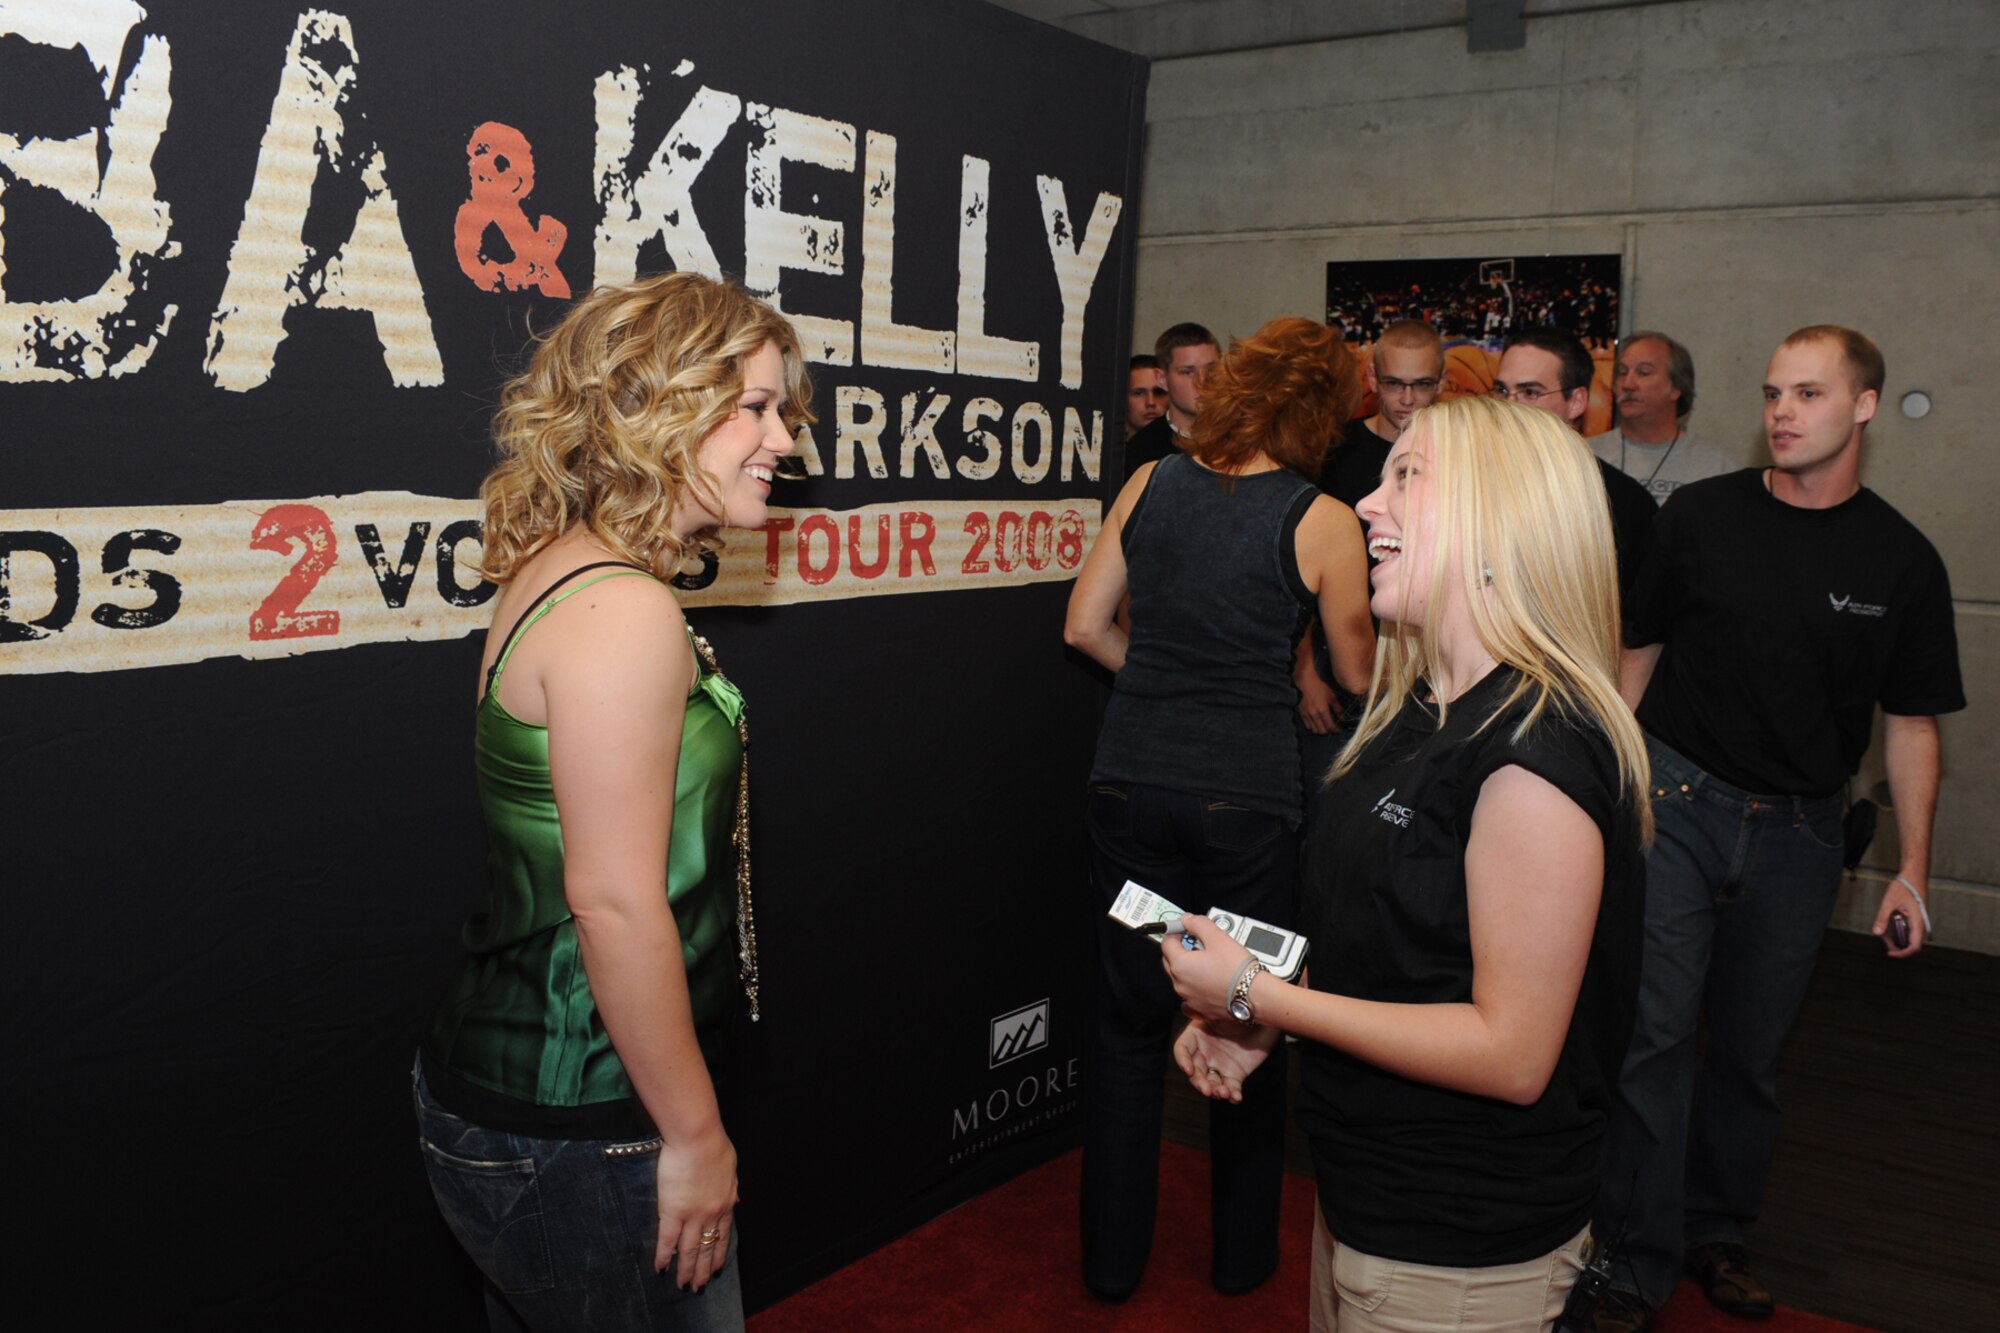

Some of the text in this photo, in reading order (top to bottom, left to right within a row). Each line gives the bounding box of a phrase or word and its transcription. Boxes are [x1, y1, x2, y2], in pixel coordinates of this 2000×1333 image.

[454, 121, 571, 299] &
[593, 60, 1123, 390] KELLY
[753, 511, 938, 586] TOUR
[961, 508, 1087, 575] 2008
[951, 1057, 1080, 1141] MOORE
